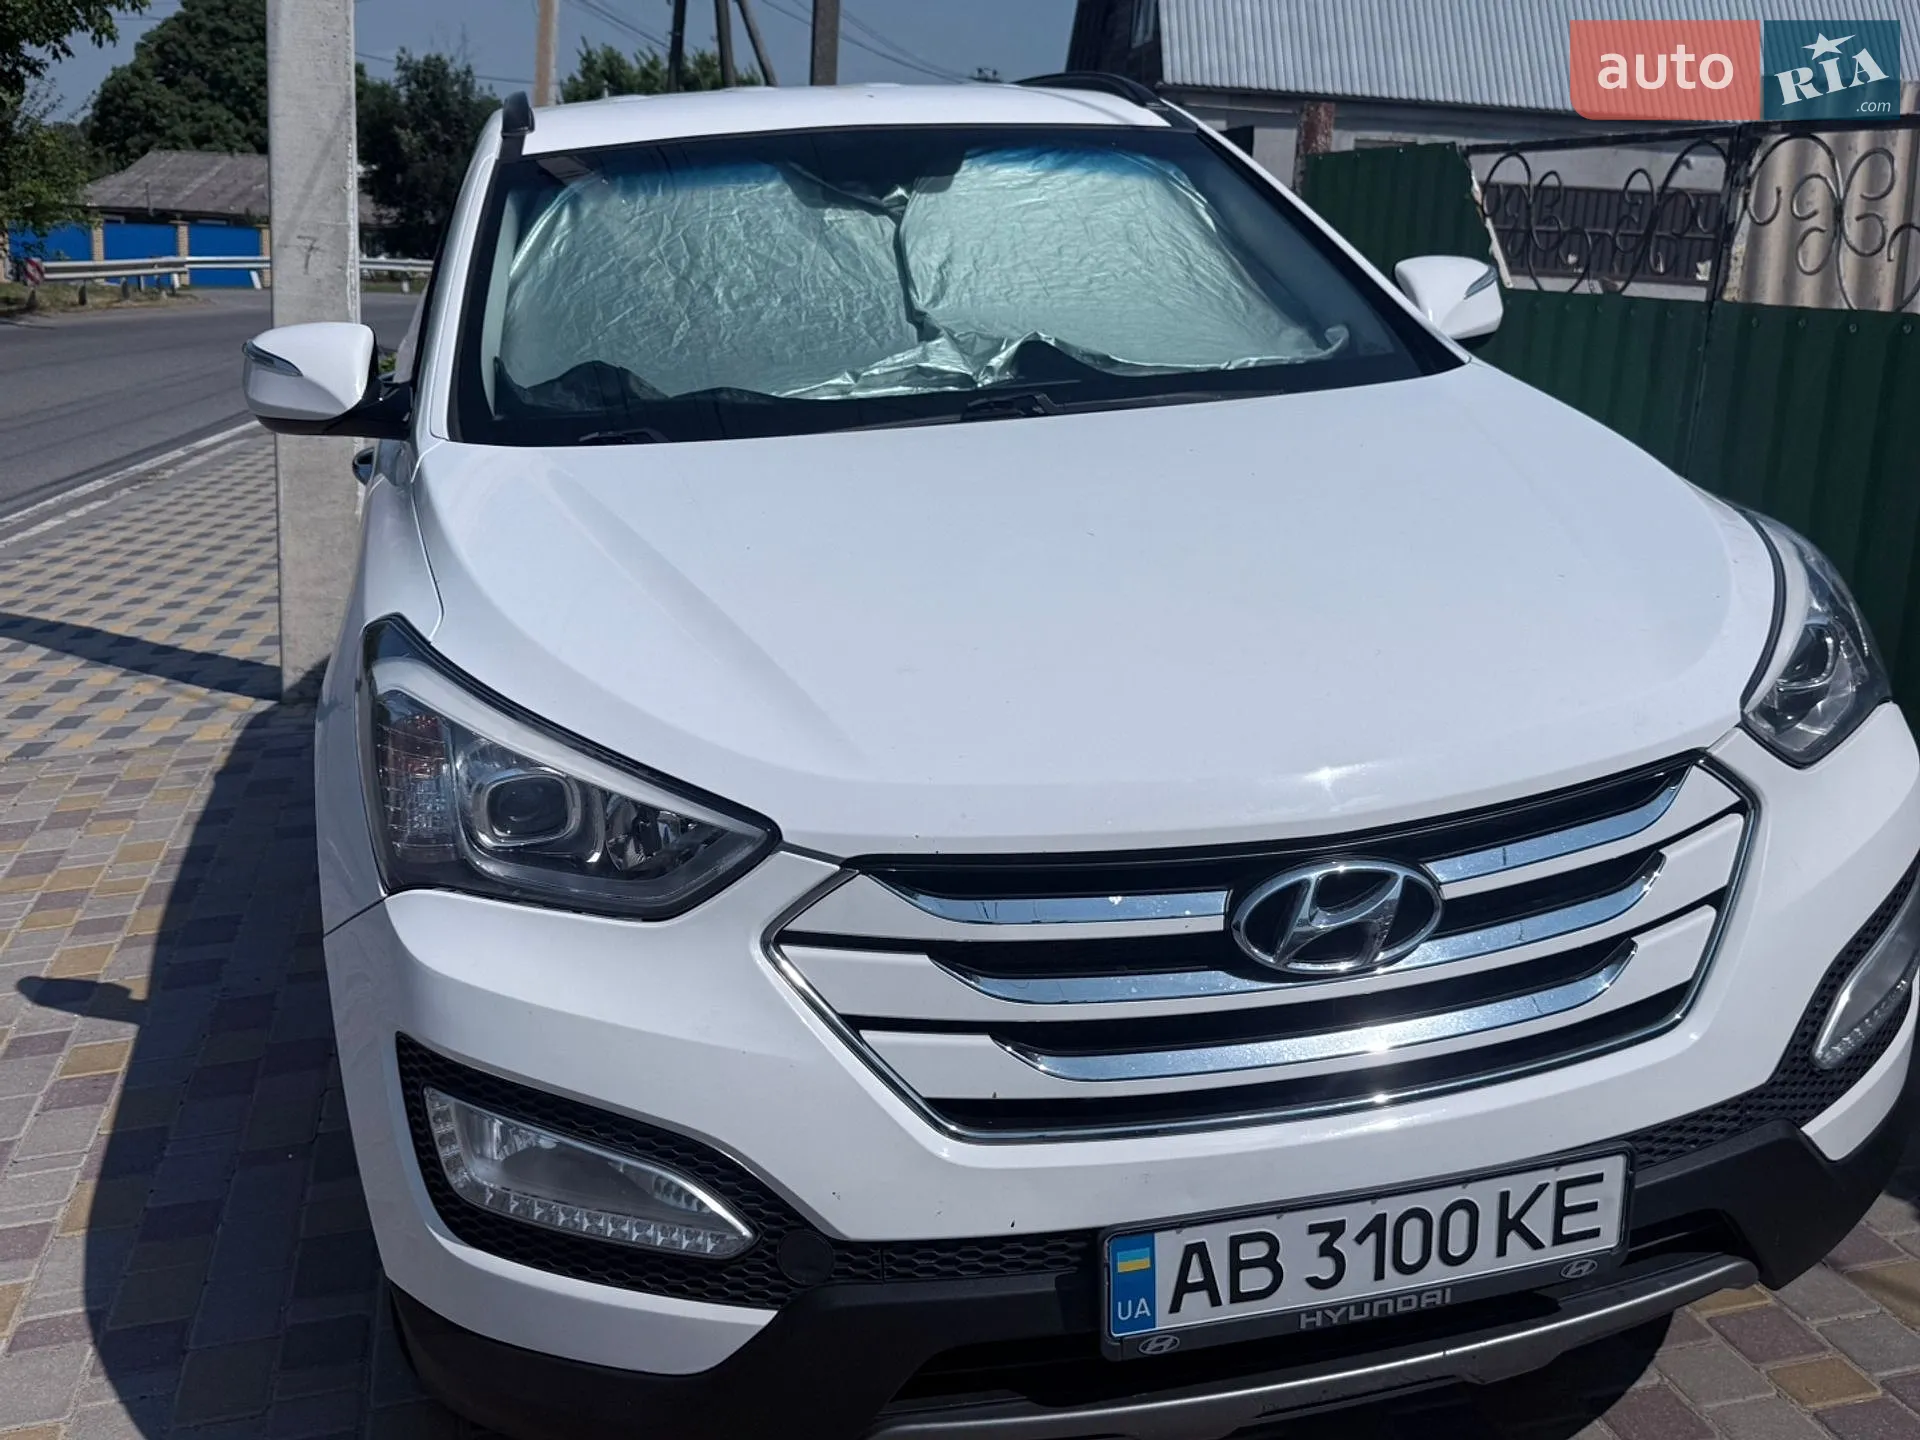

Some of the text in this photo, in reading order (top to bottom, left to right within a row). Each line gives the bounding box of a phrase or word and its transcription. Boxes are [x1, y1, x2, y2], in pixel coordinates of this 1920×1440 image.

[1168, 1172, 1604, 1314] AB 3100 KE
[1116, 1297, 1152, 1321] UA
[1299, 1288, 1452, 1330] HYUNDAI
